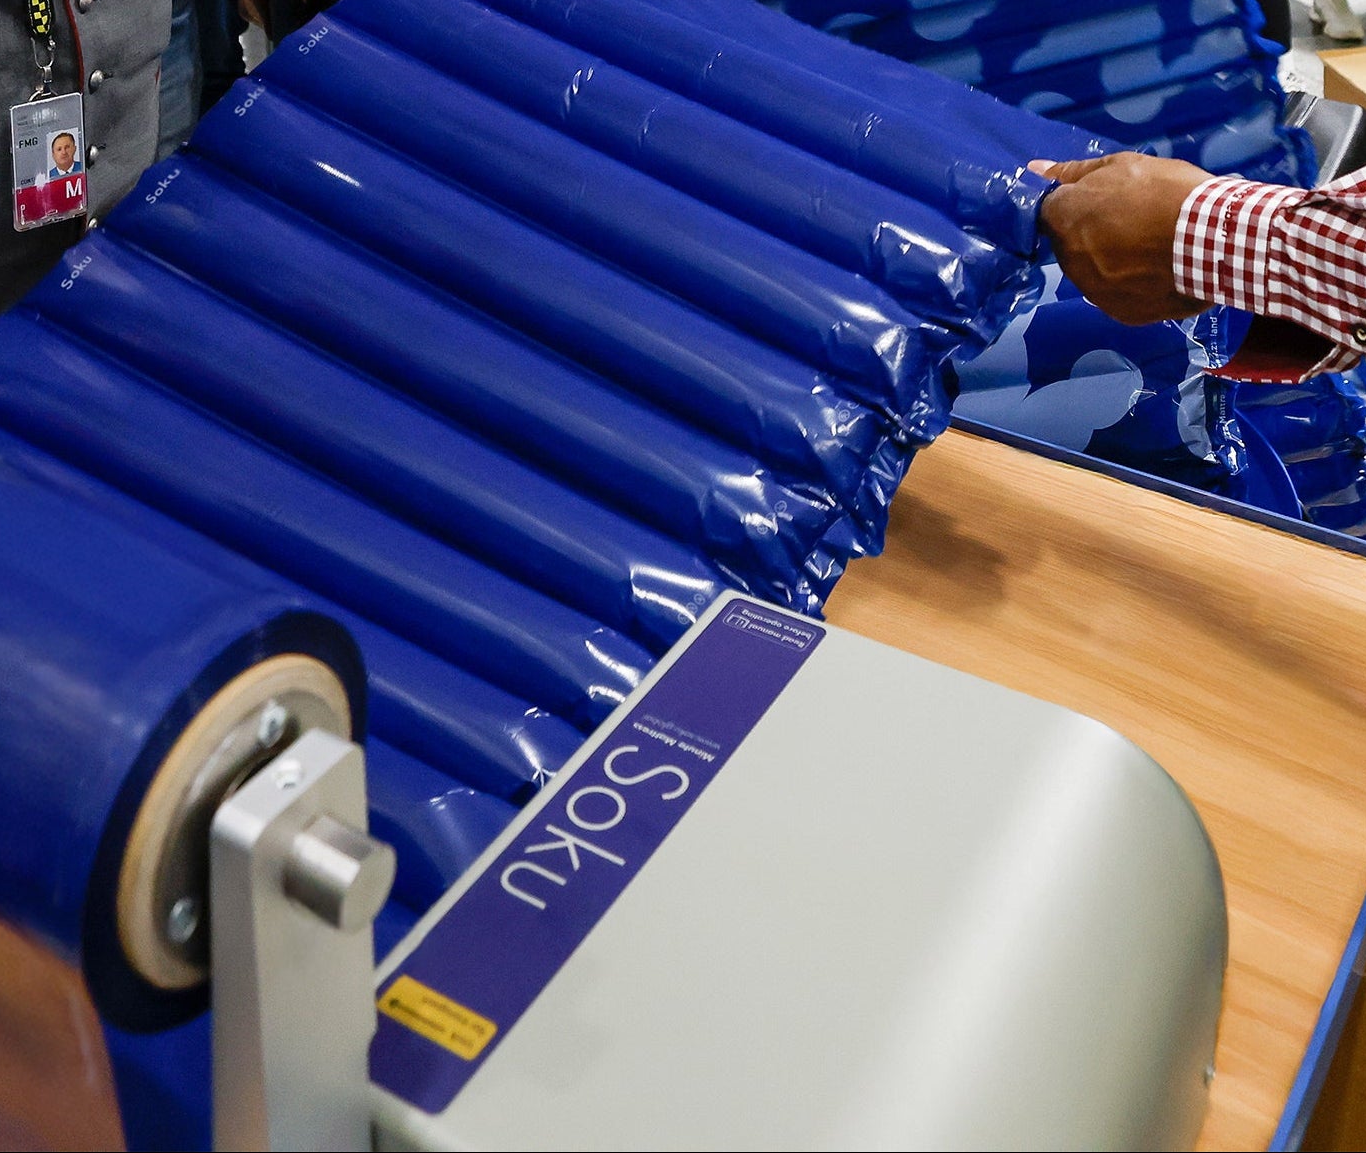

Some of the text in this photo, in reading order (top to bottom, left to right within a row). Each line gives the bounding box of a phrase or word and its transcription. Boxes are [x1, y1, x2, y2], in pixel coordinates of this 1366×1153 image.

[298, 26, 329, 55] Soku
[18, 136, 38, 149] FMG
[65, 177, 83, 199] M
[145, 168, 181, 204] Soku
[60, 255, 92, 290] Soku
[741, 608, 812, 640] before operating
[748, 622, 806, 649] Read manual
[633, 721, 715, 763] Minute Mattress
[499, 744, 691, 911] Soku
